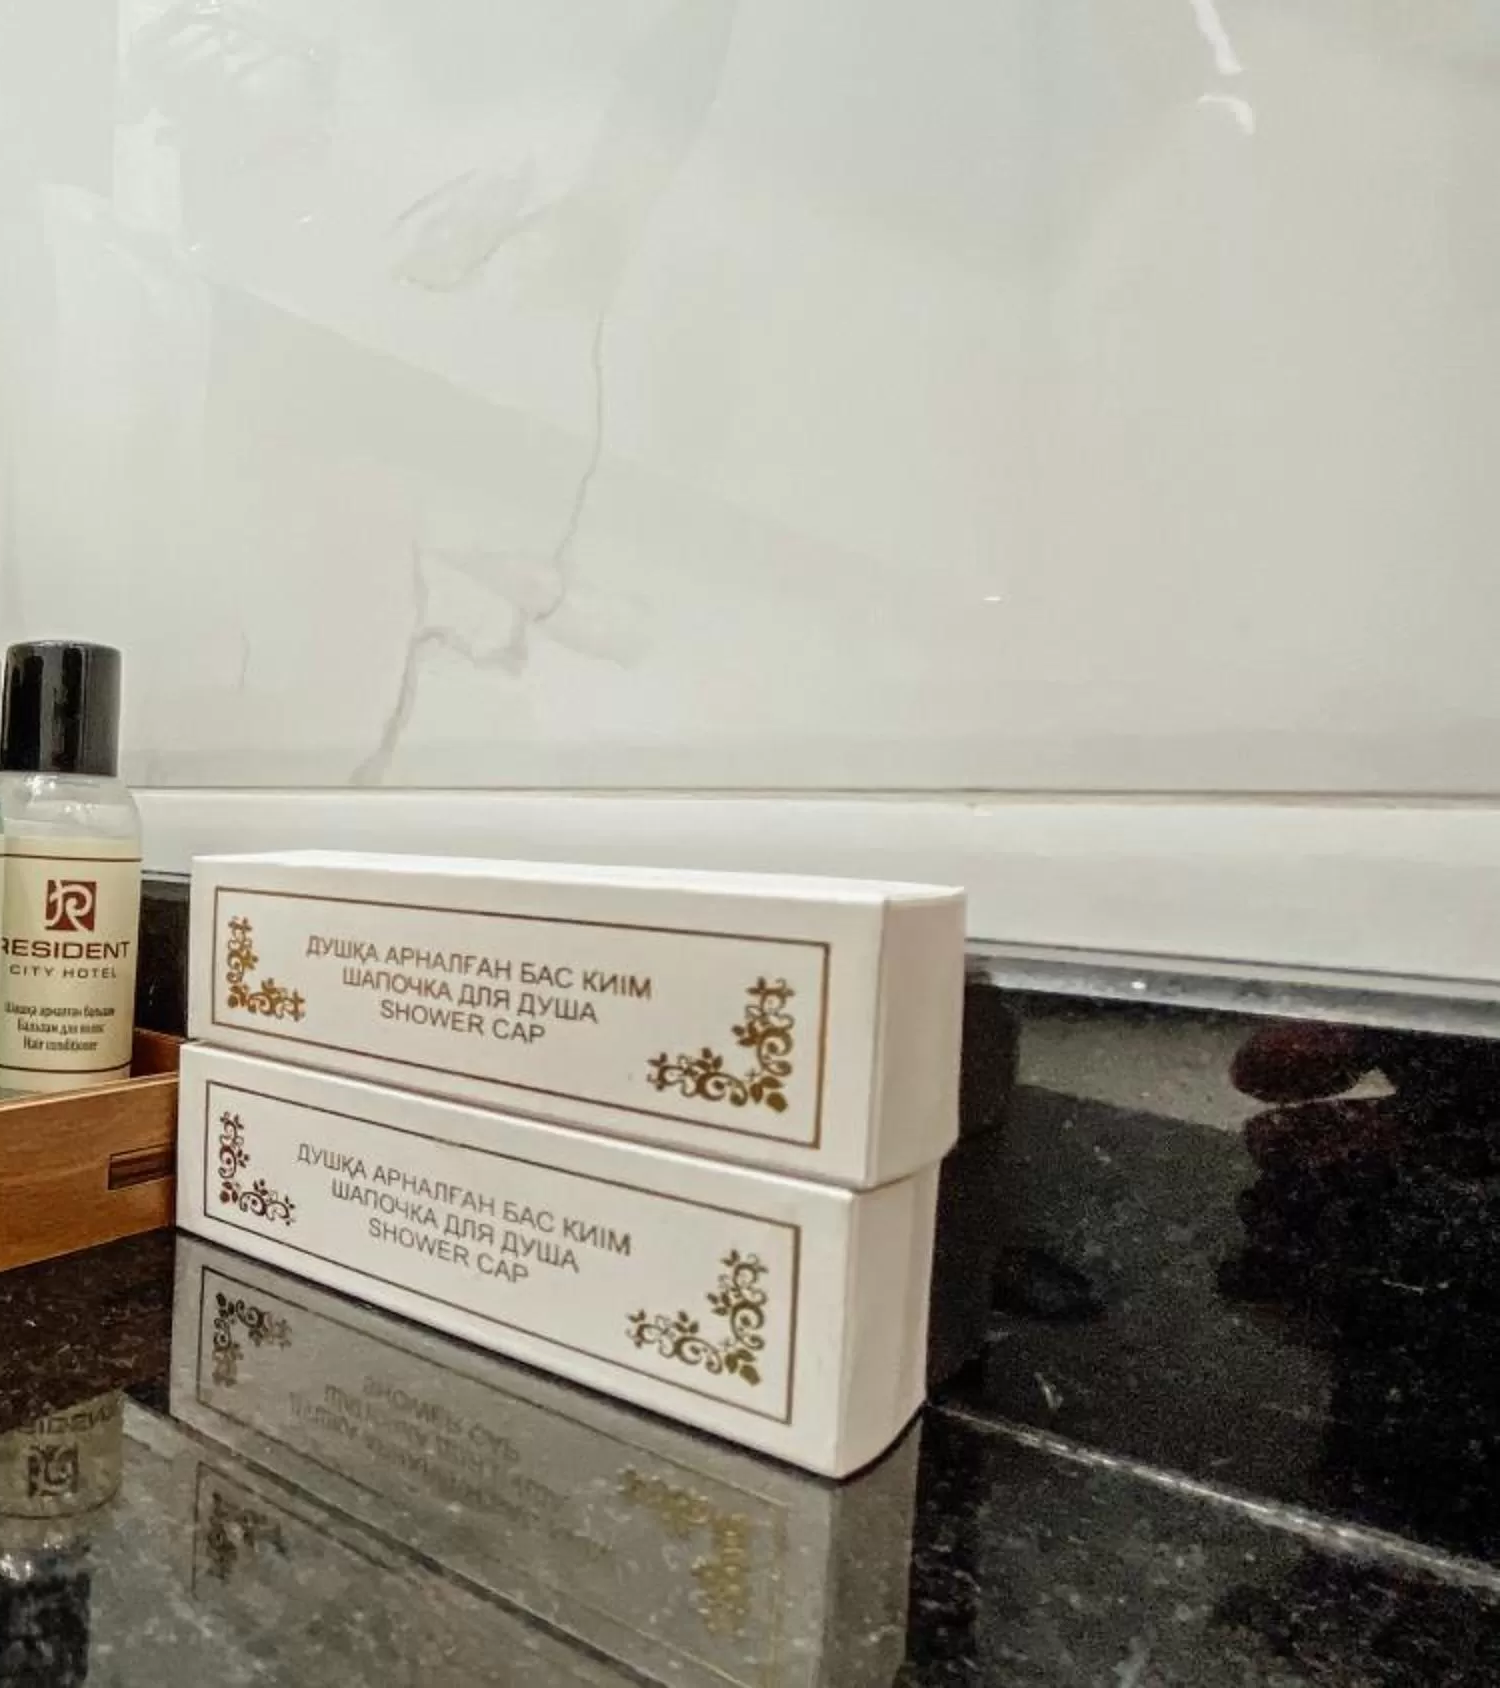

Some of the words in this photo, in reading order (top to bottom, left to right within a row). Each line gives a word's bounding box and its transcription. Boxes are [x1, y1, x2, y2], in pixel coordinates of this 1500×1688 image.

[1, 937, 130, 959] RESIDENT
[9, 964, 54, 977] CITY
[62, 966, 116, 979] HOTEL
[385, 947, 512, 981] АРНАЛҒАН
[520, 962, 574, 989] БАС
[582, 970, 653, 1001] КИІМ
[342, 966, 453, 1001] ШАПОЧКА
[457, 983, 511, 1011] ДЛЯ
[516, 993, 599, 1024] ДУША
[379, 999, 485, 1036] SHOWER
[492, 1018, 546, 1044] CAP
[331, 1177, 438, 1229] ШАПОЧКА
[443, 1214, 495, 1246] ДЛЯ
[500, 1230, 581, 1274] ДУША
[367, 1217, 470, 1267] SHOWER
[476, 1253, 530, 1284] CAP
[502, 1201, 556, 1234] БАС
[562, 1216, 633, 1257] КИІМ
